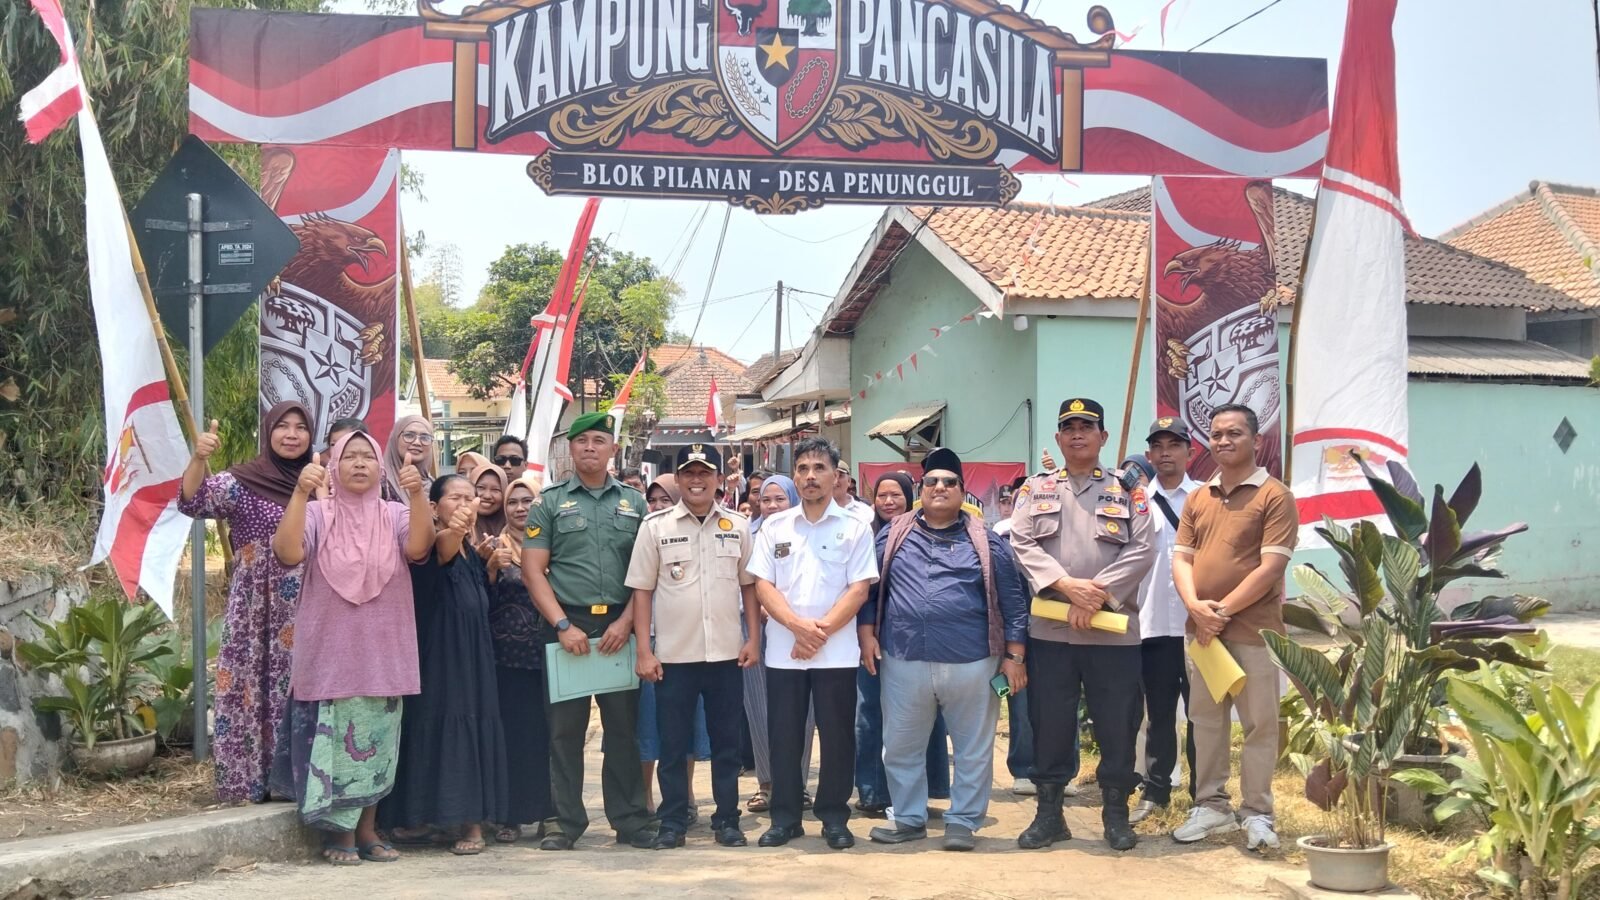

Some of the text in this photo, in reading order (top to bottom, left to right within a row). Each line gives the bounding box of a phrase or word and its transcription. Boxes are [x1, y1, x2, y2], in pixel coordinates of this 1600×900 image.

[492, 0, 1057, 154] KAMPUNG PANCASILA
[582, 163, 645, 187] BLOK
[653, 165, 752, 191] PILANAN
[778, 170, 835, 193] DESA
[844, 172, 974, 197] PENUNGGUL
[1098, 495, 1128, 506] POLRI
